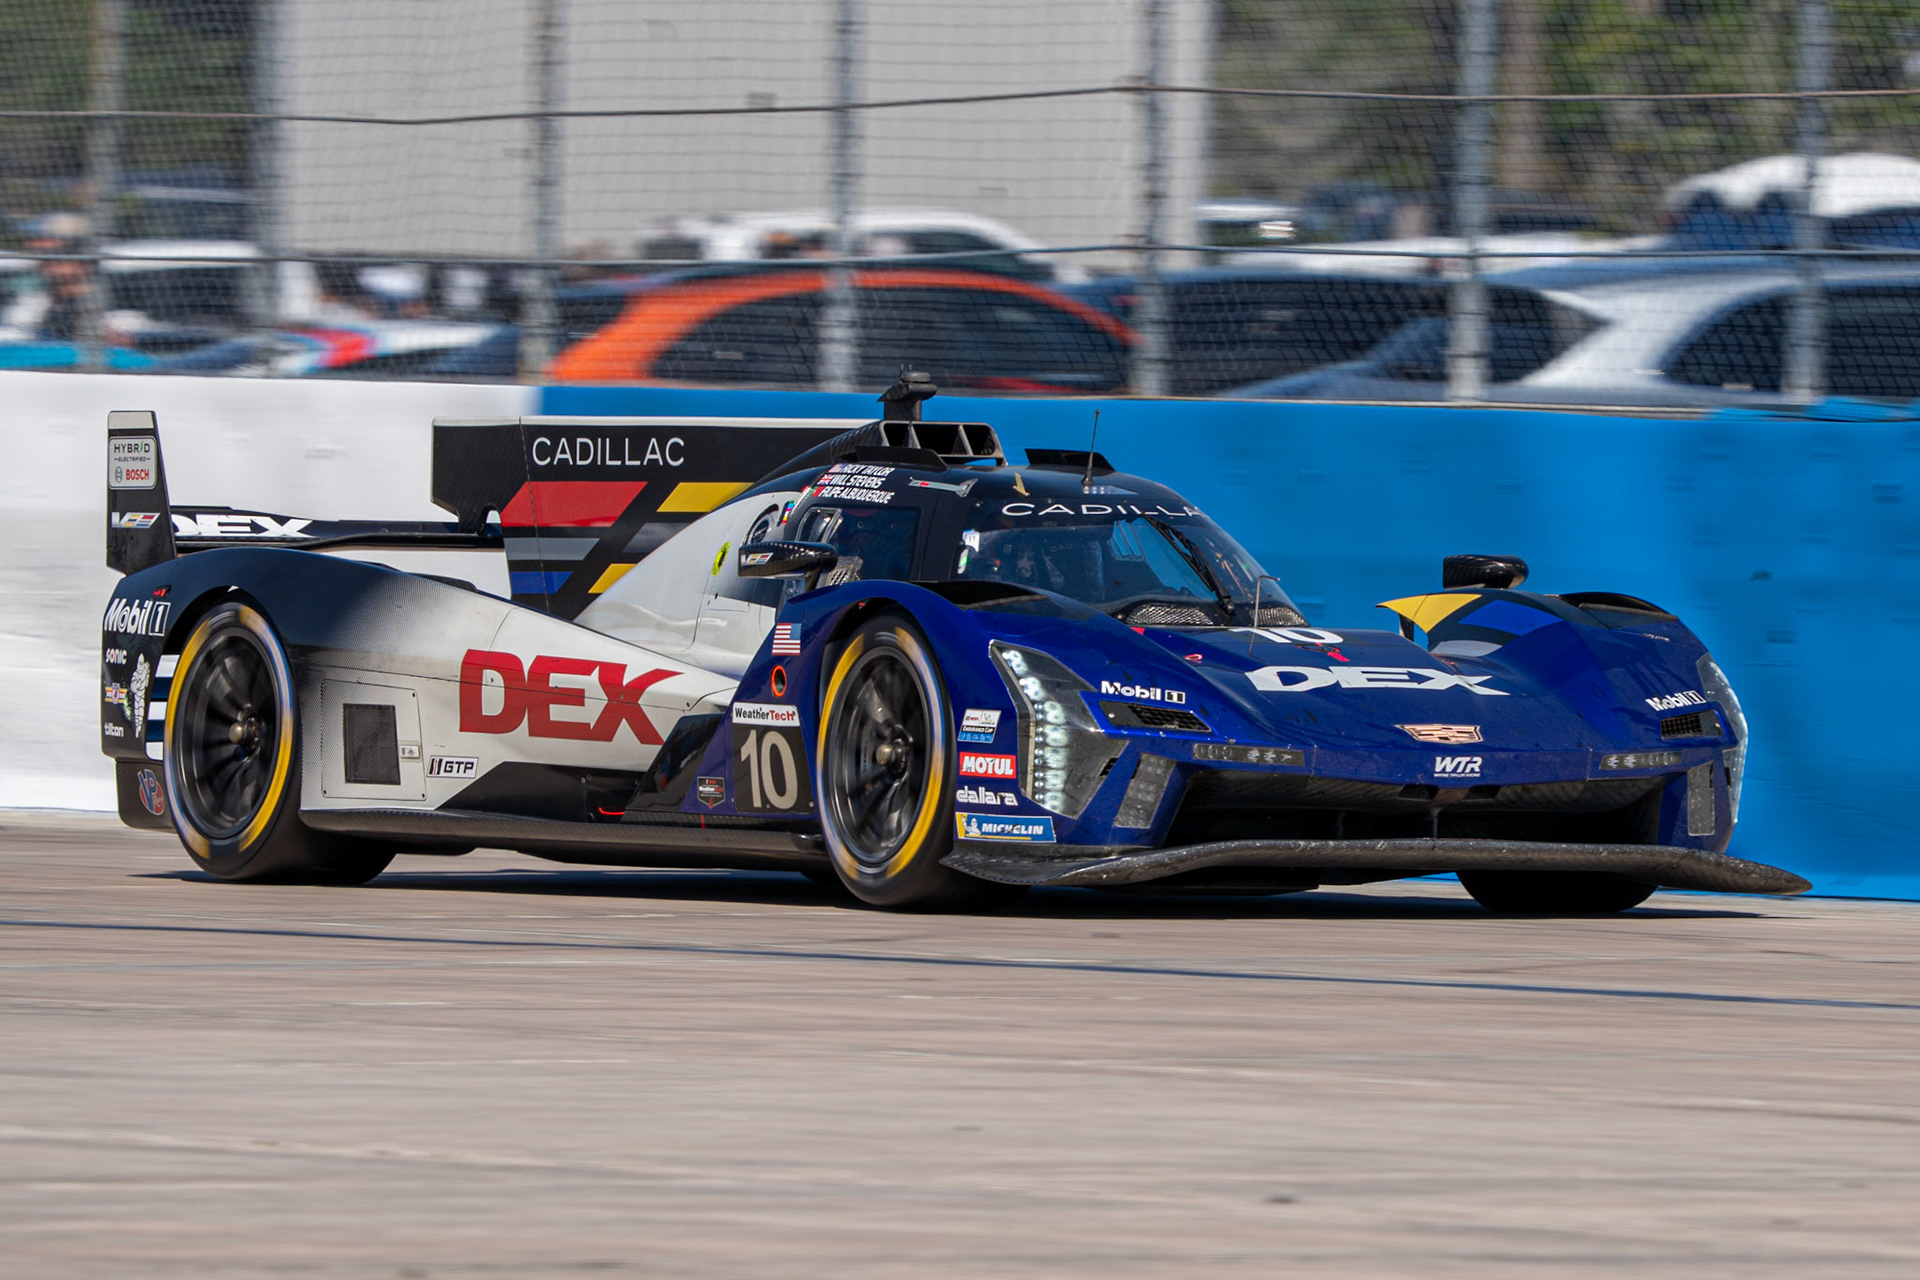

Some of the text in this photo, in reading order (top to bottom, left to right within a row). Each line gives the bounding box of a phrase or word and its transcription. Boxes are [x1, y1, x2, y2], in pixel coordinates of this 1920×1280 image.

[532, 437, 685, 467] CADILLAC
[125, 468, 149, 481] BOSCH
[104, 598, 153, 635] Mobil
[1228, 628, 1344, 644] 10
[1101, 681, 1162, 700] Mobil
[1245, 666, 1510, 696] DEX
[459, 649, 684, 746] DEX
[1645, 692, 1692, 711] Mobil
[735, 707, 795, 721] WeatherTech
[443, 760, 474, 774] GTP
[741, 729, 798, 810] 10
[962, 756, 1014, 775] MOTUL
[1435, 756, 1482, 773] WTR
[956, 785, 1018, 806] dallara
[982, 823, 1044, 835] MICHELIN
